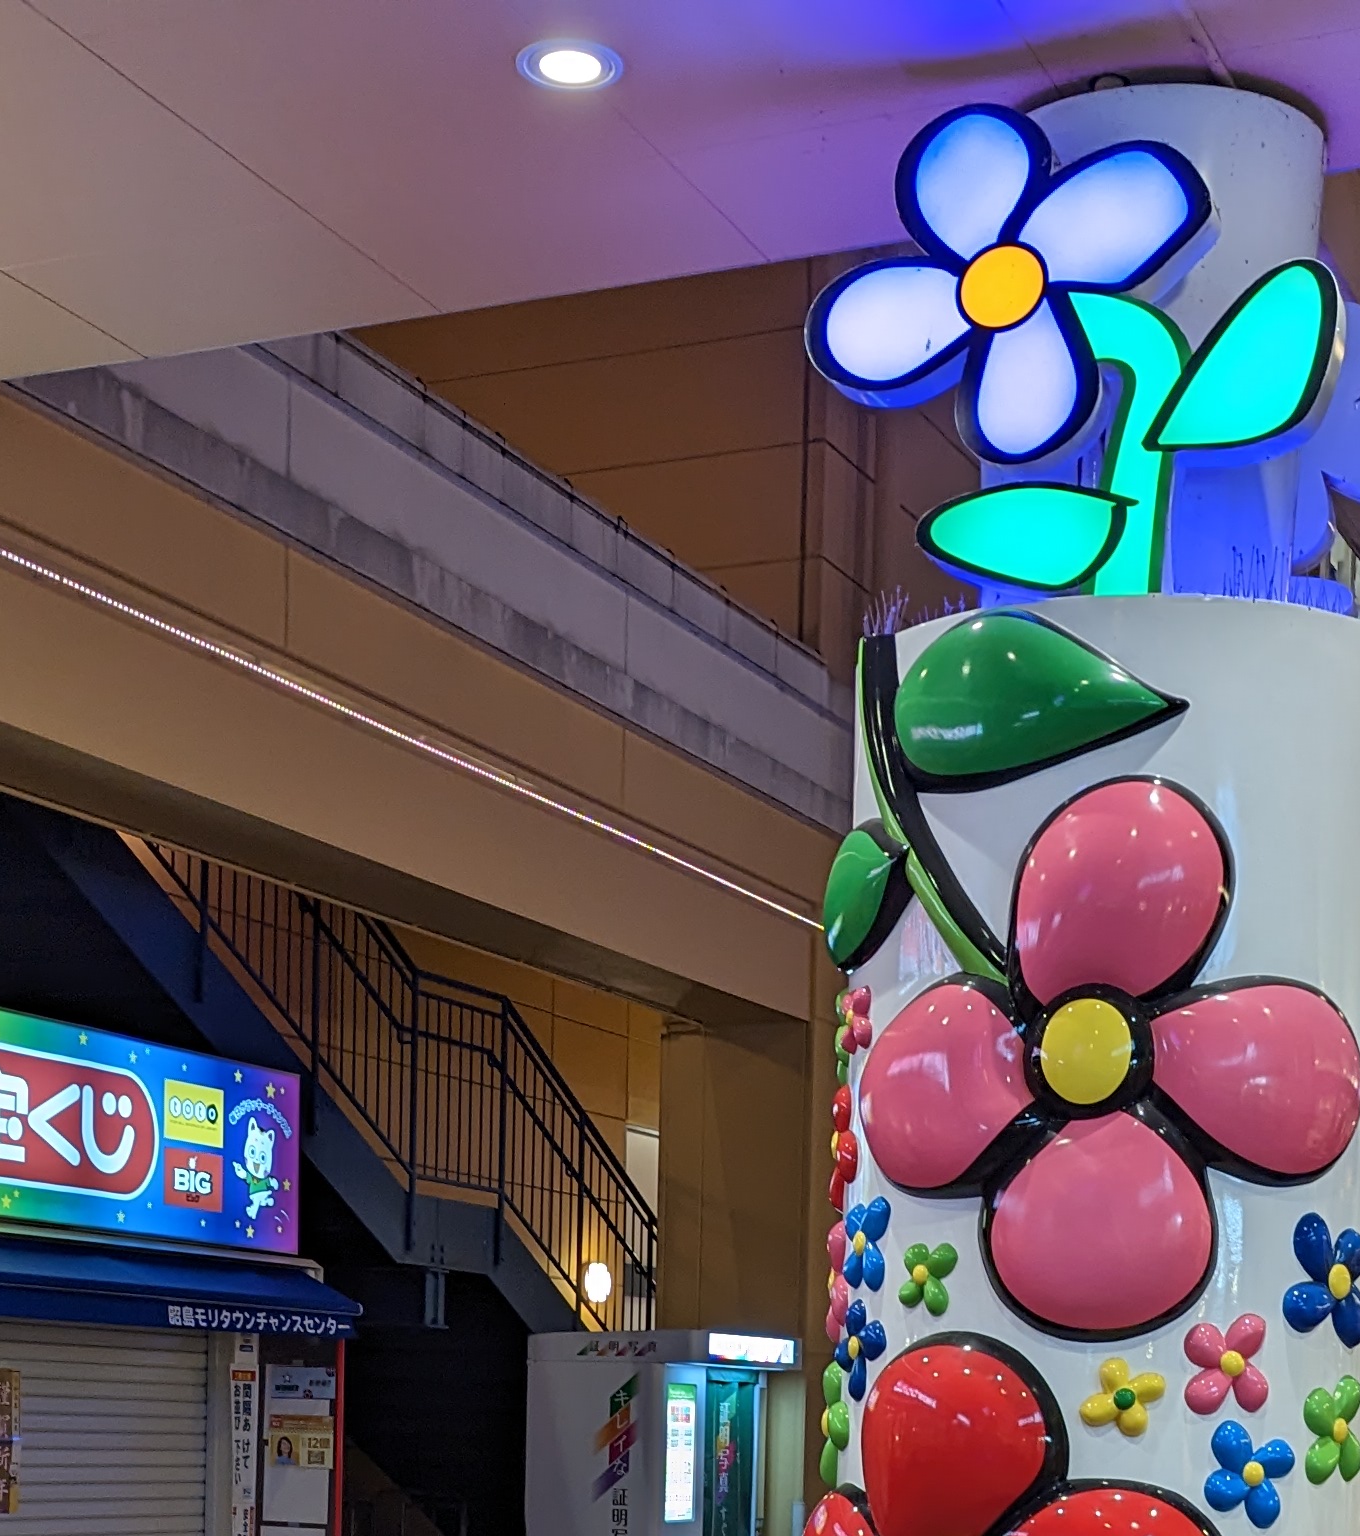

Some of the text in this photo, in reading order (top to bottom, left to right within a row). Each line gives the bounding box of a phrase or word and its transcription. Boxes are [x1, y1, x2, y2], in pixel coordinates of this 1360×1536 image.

[169, 1095, 218, 1125] toto
[173, 1167, 213, 1196] BIG
[167, 1304, 351, 1336] 昭島モリタウンチャンスセンター
